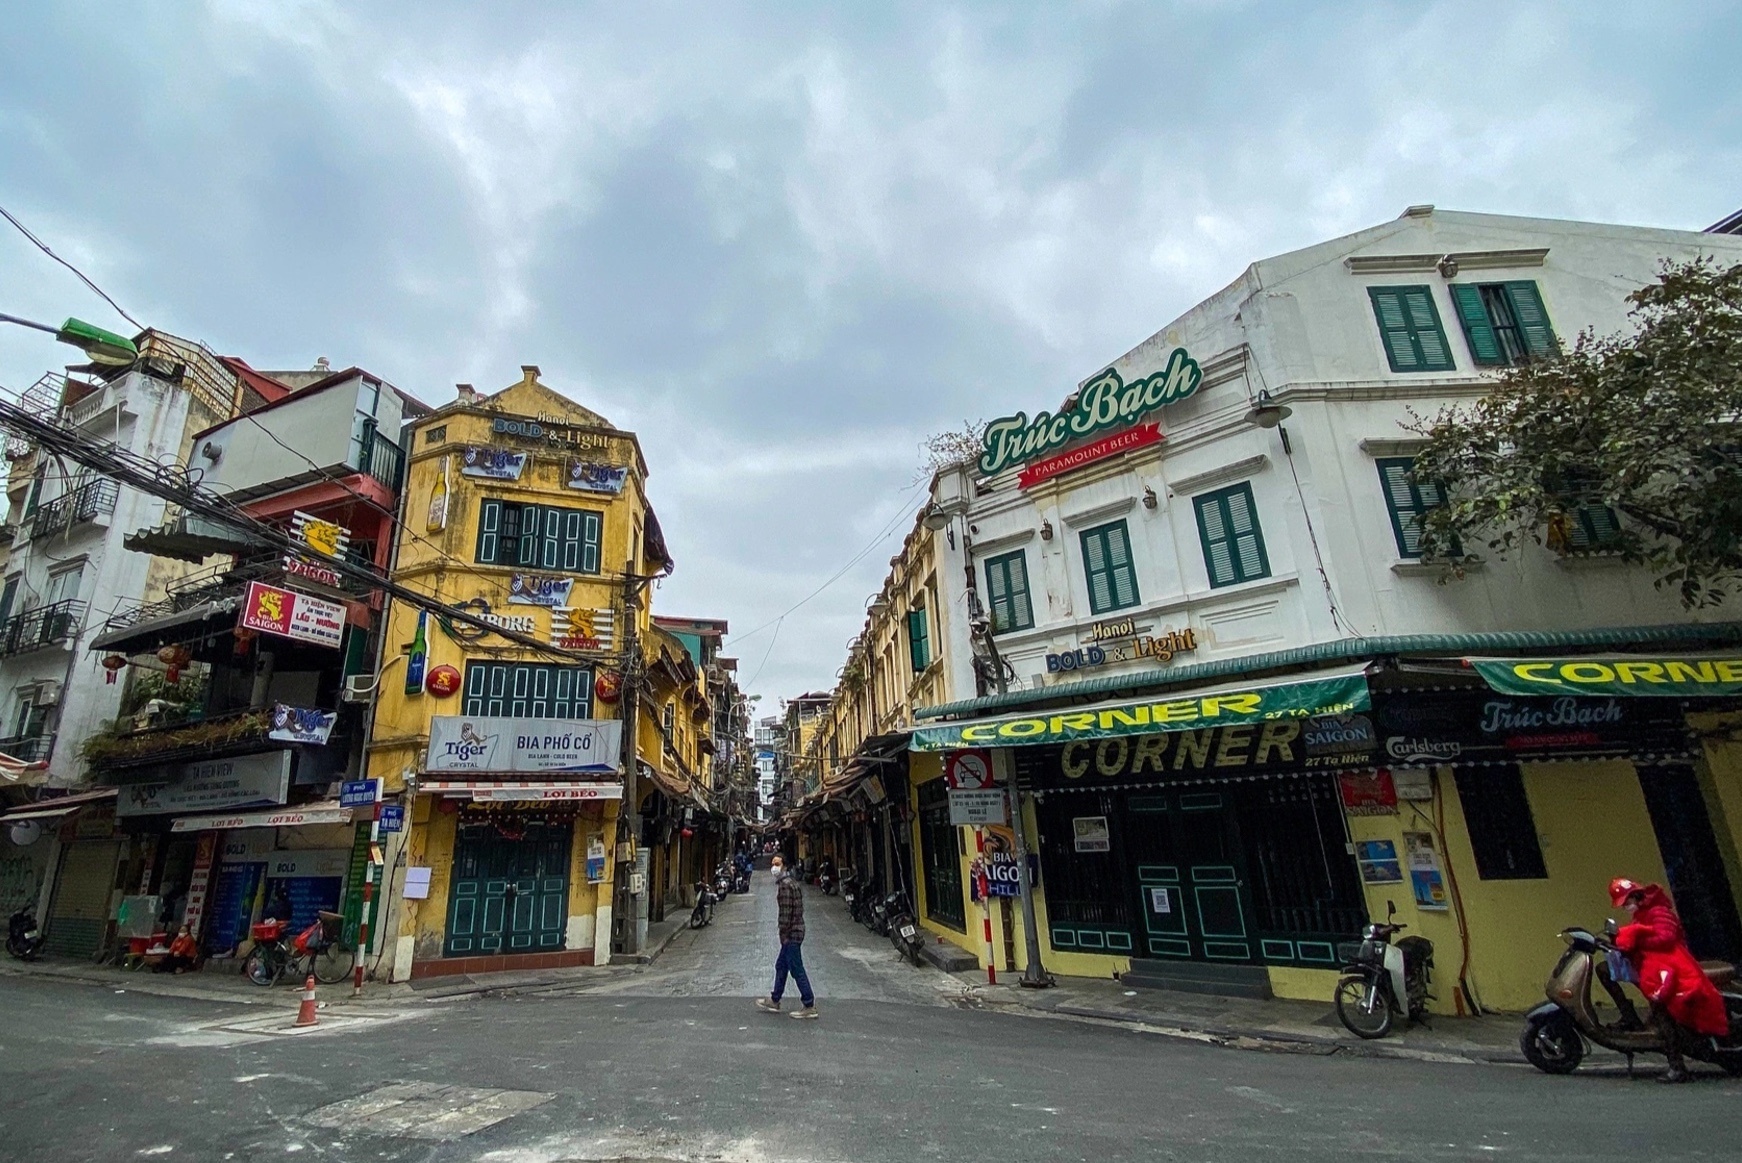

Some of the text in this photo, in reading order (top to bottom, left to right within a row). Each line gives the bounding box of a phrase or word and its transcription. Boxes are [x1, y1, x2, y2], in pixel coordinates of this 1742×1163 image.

[538, 410, 570, 426] Hanoi
[981, 352, 1197, 472] Trúc Bạch
[493, 418, 609, 450] BOLD & Light
[1034, 431, 1140, 477] PARAMOUNT BEER
[248, 616, 285, 631] SAIGON
[459, 612, 535, 633] BORG
[1092, 617, 1135, 640] Hanoi
[1045, 628, 1198, 673] BOLD & Light
[961, 693, 1263, 741] CORNER
[1265, 711, 1283, 719] 27
[1480, 701, 1544, 733] Trúc
[1546, 697, 1624, 727] Bạch
[1321, 720, 1342, 730] BIA
[517, 732, 593, 750] BIA PHỐ CỔ
[1304, 728, 1369, 745] SAIGON
[445, 740, 488, 761] Tiger
[1060, 720, 1301, 779] CORNER
[1386, 736, 1462, 760] Carlsberg
[449, 761, 479, 769] CRYSTAL
[1304, 757, 1321, 767] 27
[570, 788, 598, 798] BÉO
[1345, 804, 1398, 816] SAIGON
[285, 814, 304, 824] BÉO
[226, 843, 246, 855] BOLD
[993, 852, 1012, 862] BIA
[276, 862, 296, 873] BOLD
